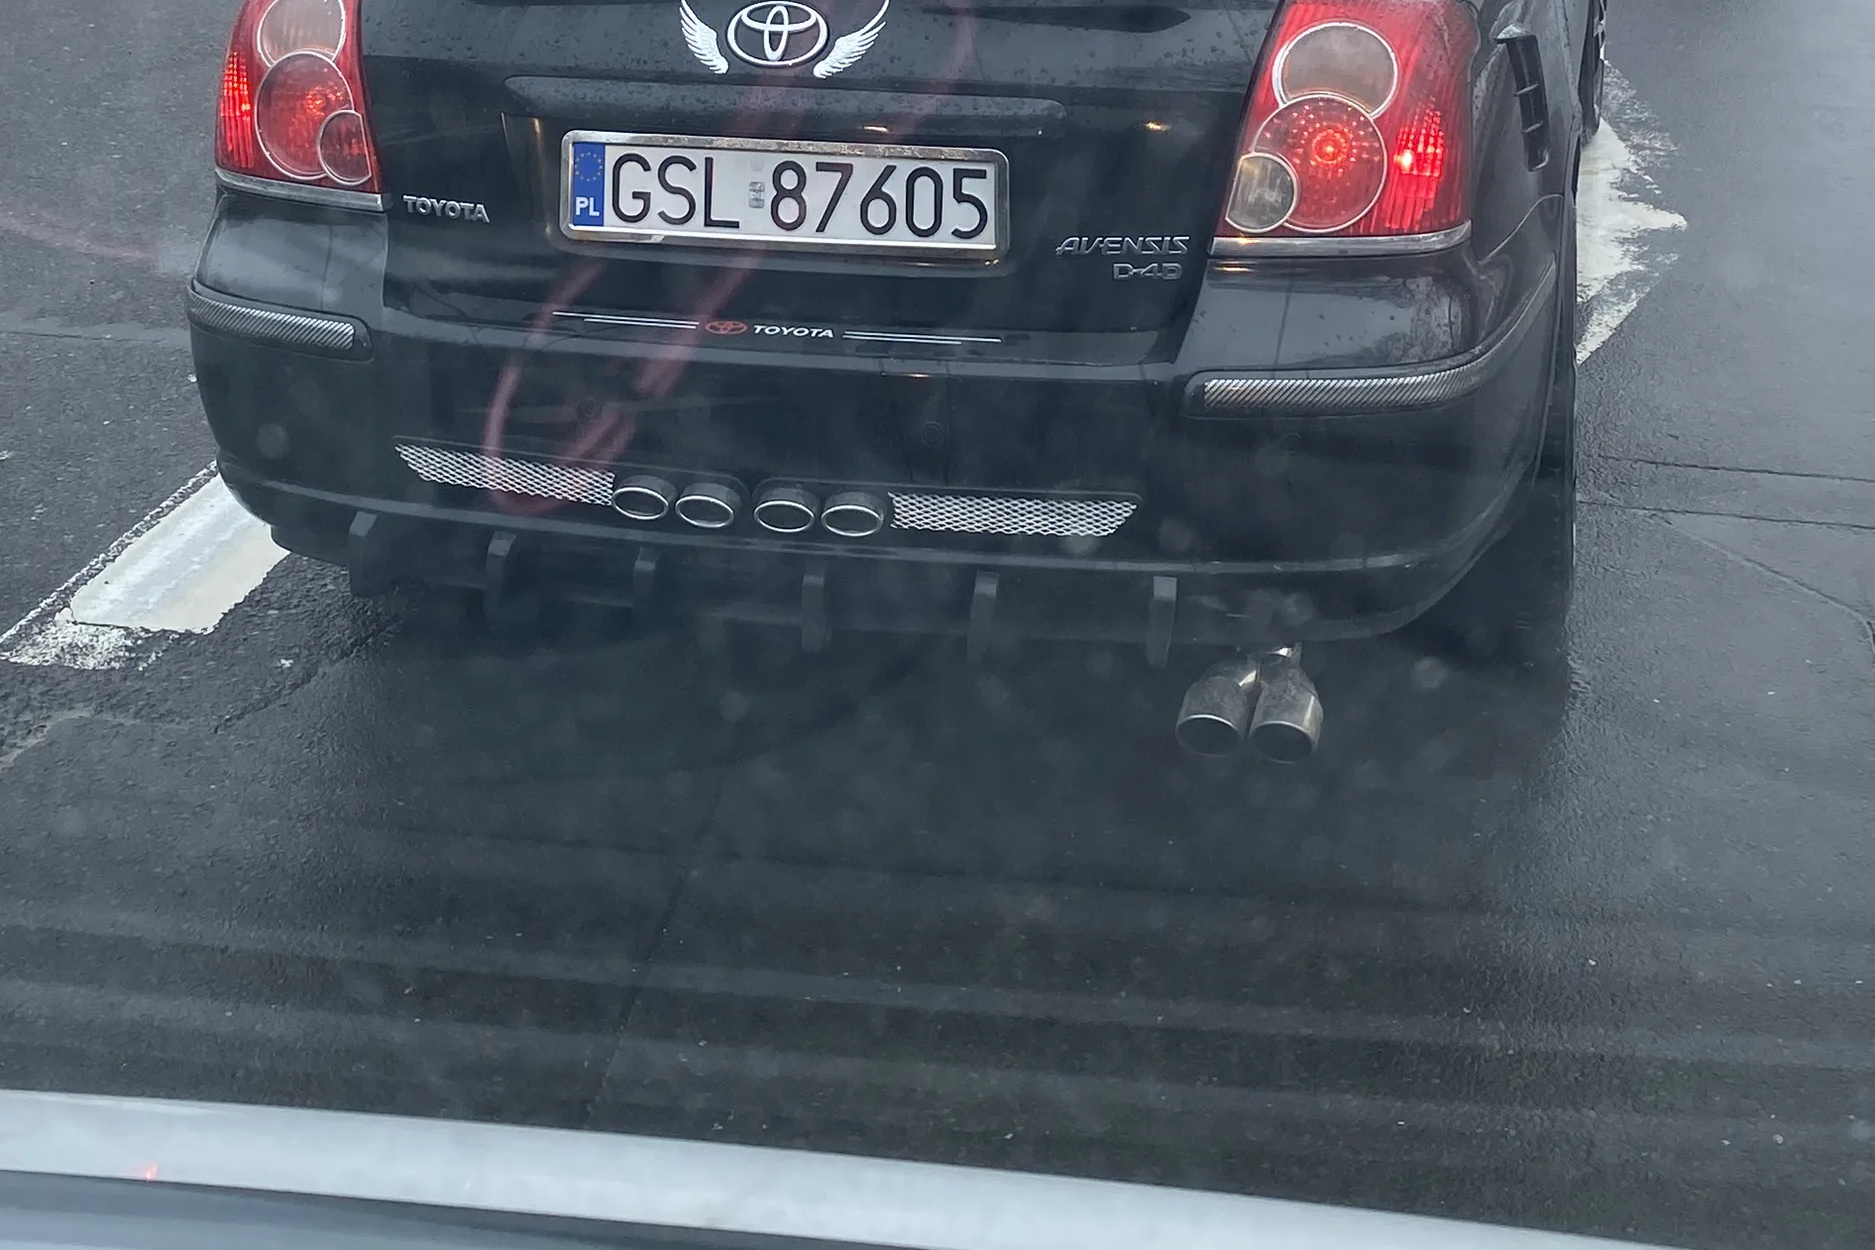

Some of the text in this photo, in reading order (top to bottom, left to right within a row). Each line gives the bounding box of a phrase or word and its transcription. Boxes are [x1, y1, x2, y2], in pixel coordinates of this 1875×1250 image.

[575, 196, 600, 217] PL
[611, 152, 988, 240] GSL 87605
[403, 195, 490, 224] TOYOTA
[1055, 236, 1190, 255] AVENSIS
[754, 325, 834, 338] TOYOTA
